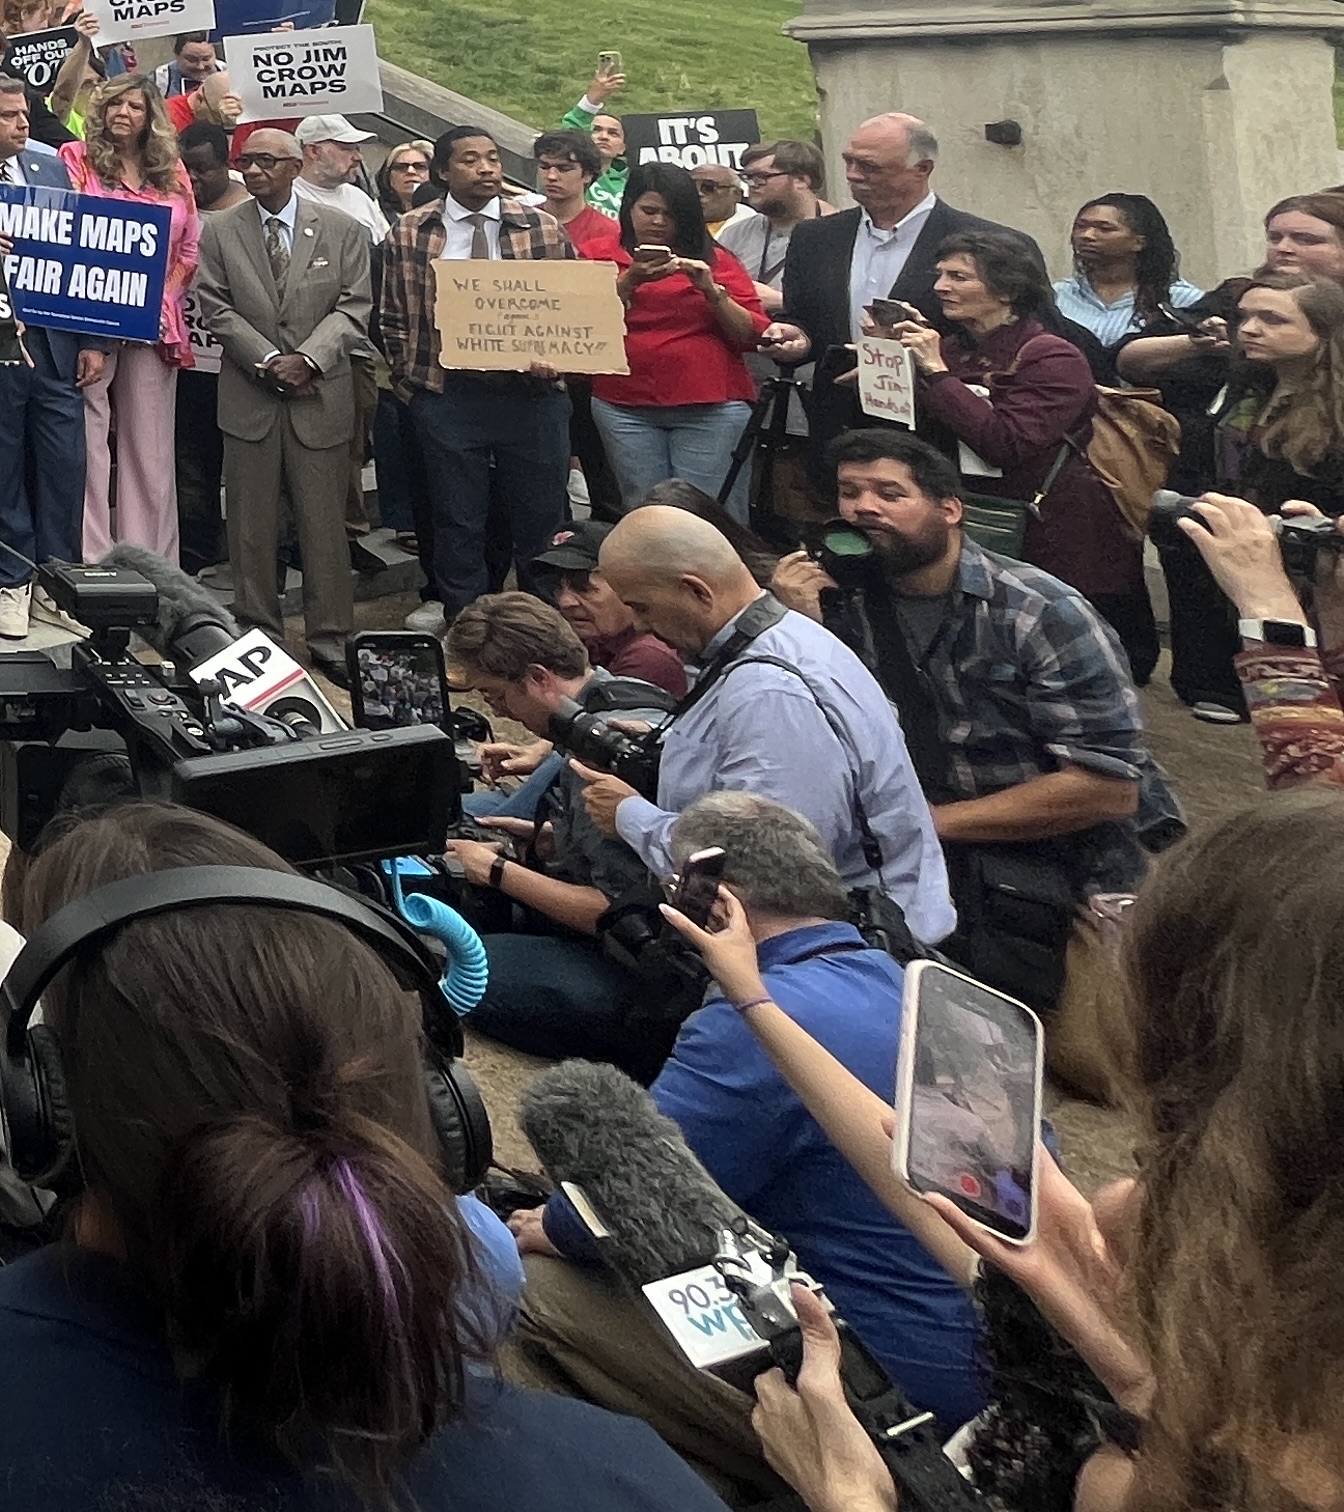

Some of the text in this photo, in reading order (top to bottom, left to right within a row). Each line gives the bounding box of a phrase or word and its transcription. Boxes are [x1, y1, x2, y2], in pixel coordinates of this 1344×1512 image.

[113, 0, 186, 22] MAPS
[253, 47, 348, 67] NO JIM
[256, 63, 347, 83] CROW
[262, 79, 348, 99] MAPS
[657, 116, 720, 145] IT'S
[81, 213, 158, 258] MAPS
[3, 254, 148, 308] FAIR AGAIN
[452, 278, 546, 293] WE SHALL
[474, 296, 562, 312] OVERCOME
[524, 325, 594, 340] AGAINST
[862, 343, 904, 376] Stop
[215, 644, 275, 700] AP
